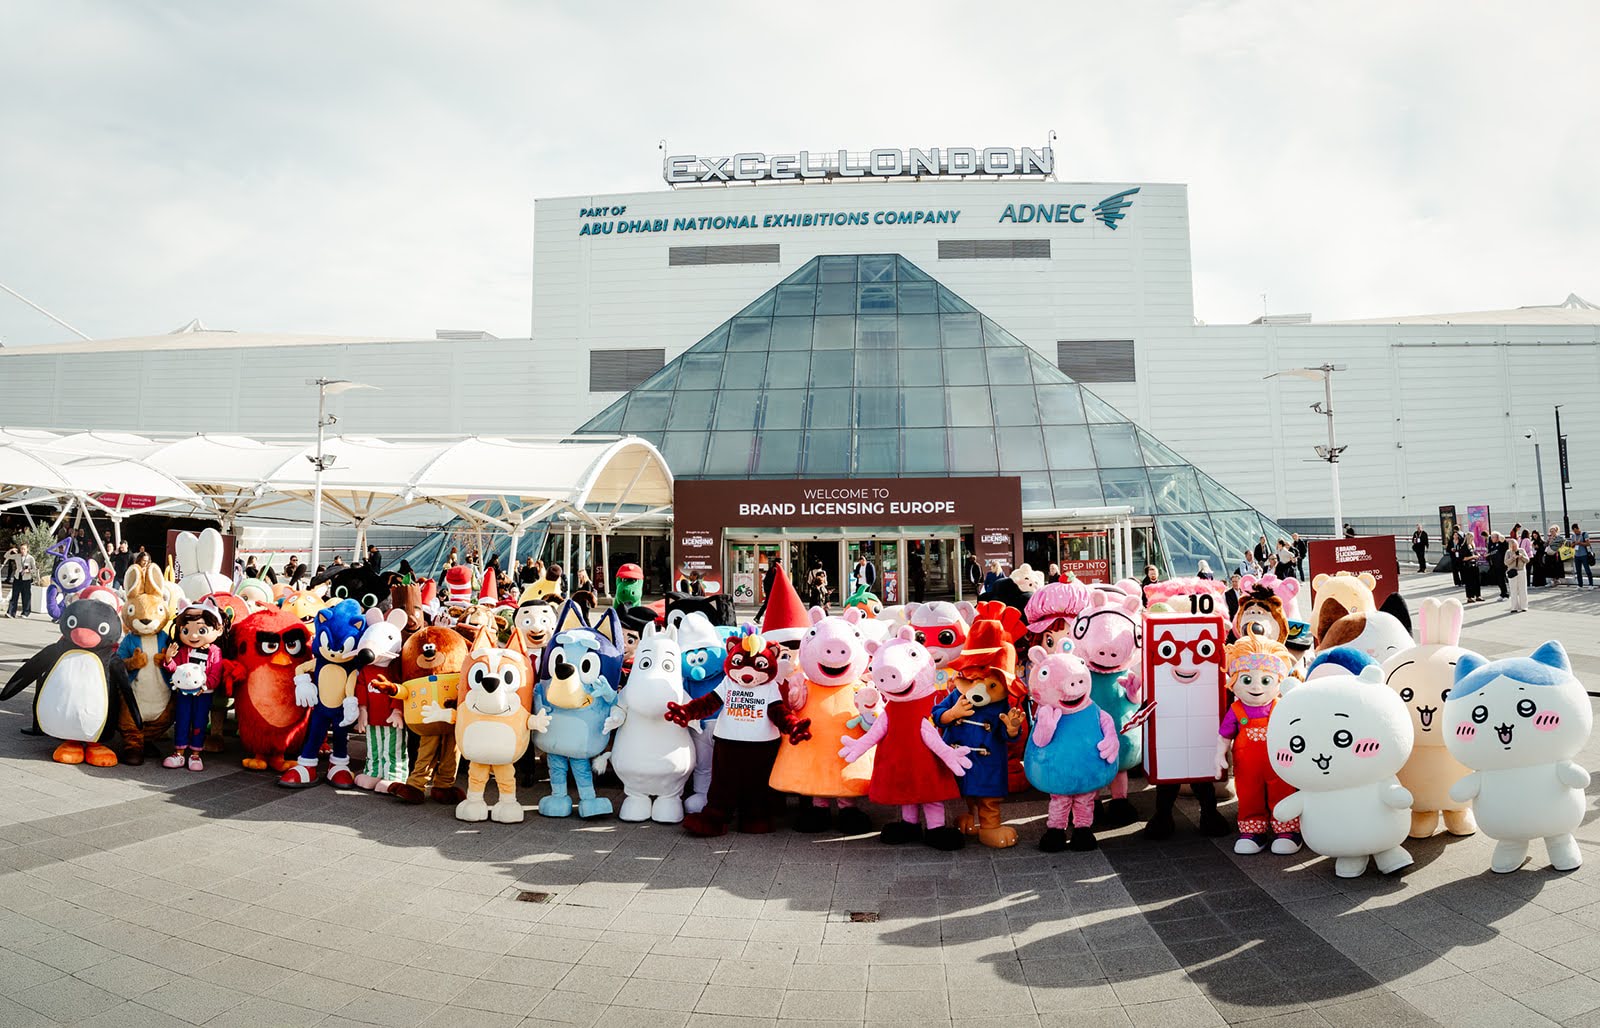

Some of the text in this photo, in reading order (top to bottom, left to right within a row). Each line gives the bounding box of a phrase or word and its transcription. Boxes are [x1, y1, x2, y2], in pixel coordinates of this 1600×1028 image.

[838, 147, 1053, 178] LONDON
[579, 206, 627, 217] PART OF
[999, 203, 1087, 223] ADNEC
[579, 210, 961, 236] ABU DHABI NATIONAL EXHIBITIONS COMPANY
[803, 488, 890, 499] WELCOME TO
[739, 501, 956, 515] BRAND LICENSING EUROPE
[1062, 561, 1107, 571] STEP INTO
[1189, 593, 1214, 615] 10
[731, 696, 765, 705] LICENSING
[728, 708, 763, 718] MABLE
